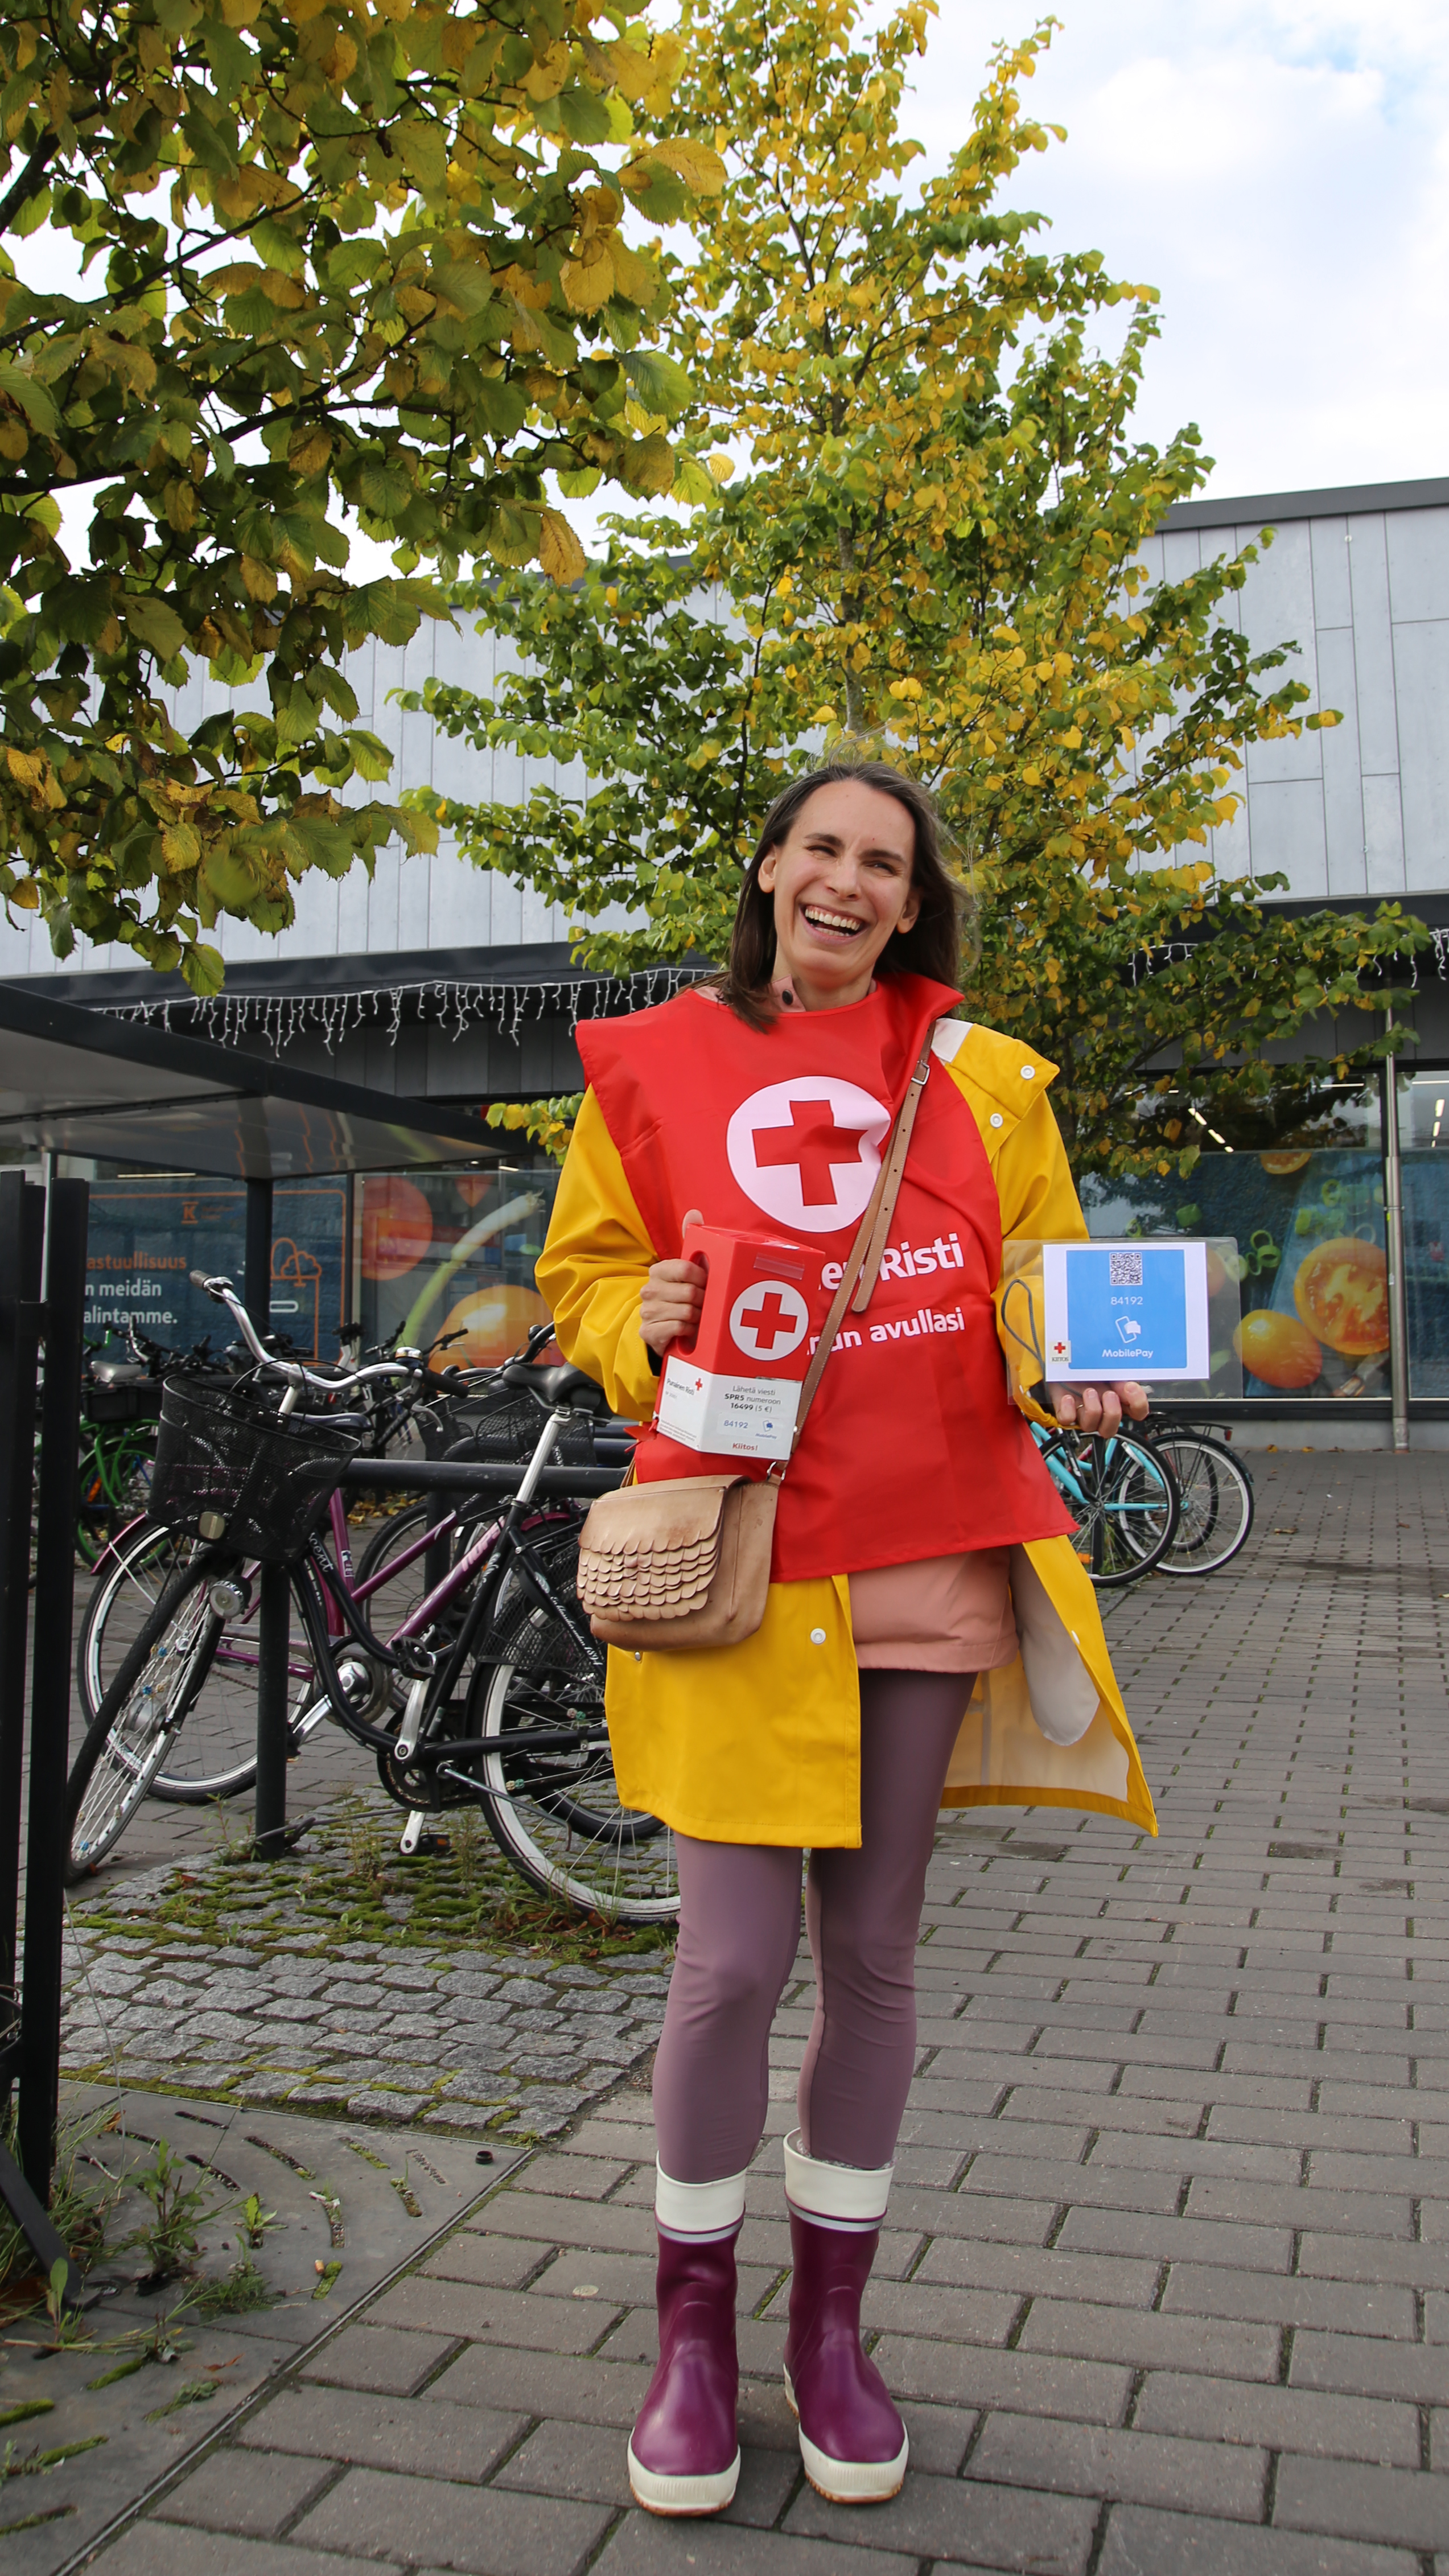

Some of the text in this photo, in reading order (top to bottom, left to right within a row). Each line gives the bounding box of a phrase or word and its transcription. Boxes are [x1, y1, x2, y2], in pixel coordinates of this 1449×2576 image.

[87, 1251, 187, 1270] astuullisuus
[879, 1233, 964, 1281] Risti
[85, 1278, 162, 1297] n meidän
[1110, 1296, 1143, 1305] 84192
[84, 1305, 178, 1324] alintamme.
[869, 1307, 965, 1342] avullasi
[1101, 1349, 1154, 1359] MobilePay
[746, 1396, 781, 1405] numeroon
[723, 1420, 749, 1429] 84192
[732, 1442, 759, 1451] Kiitos!
[584, 1647, 603, 1665] 1894
